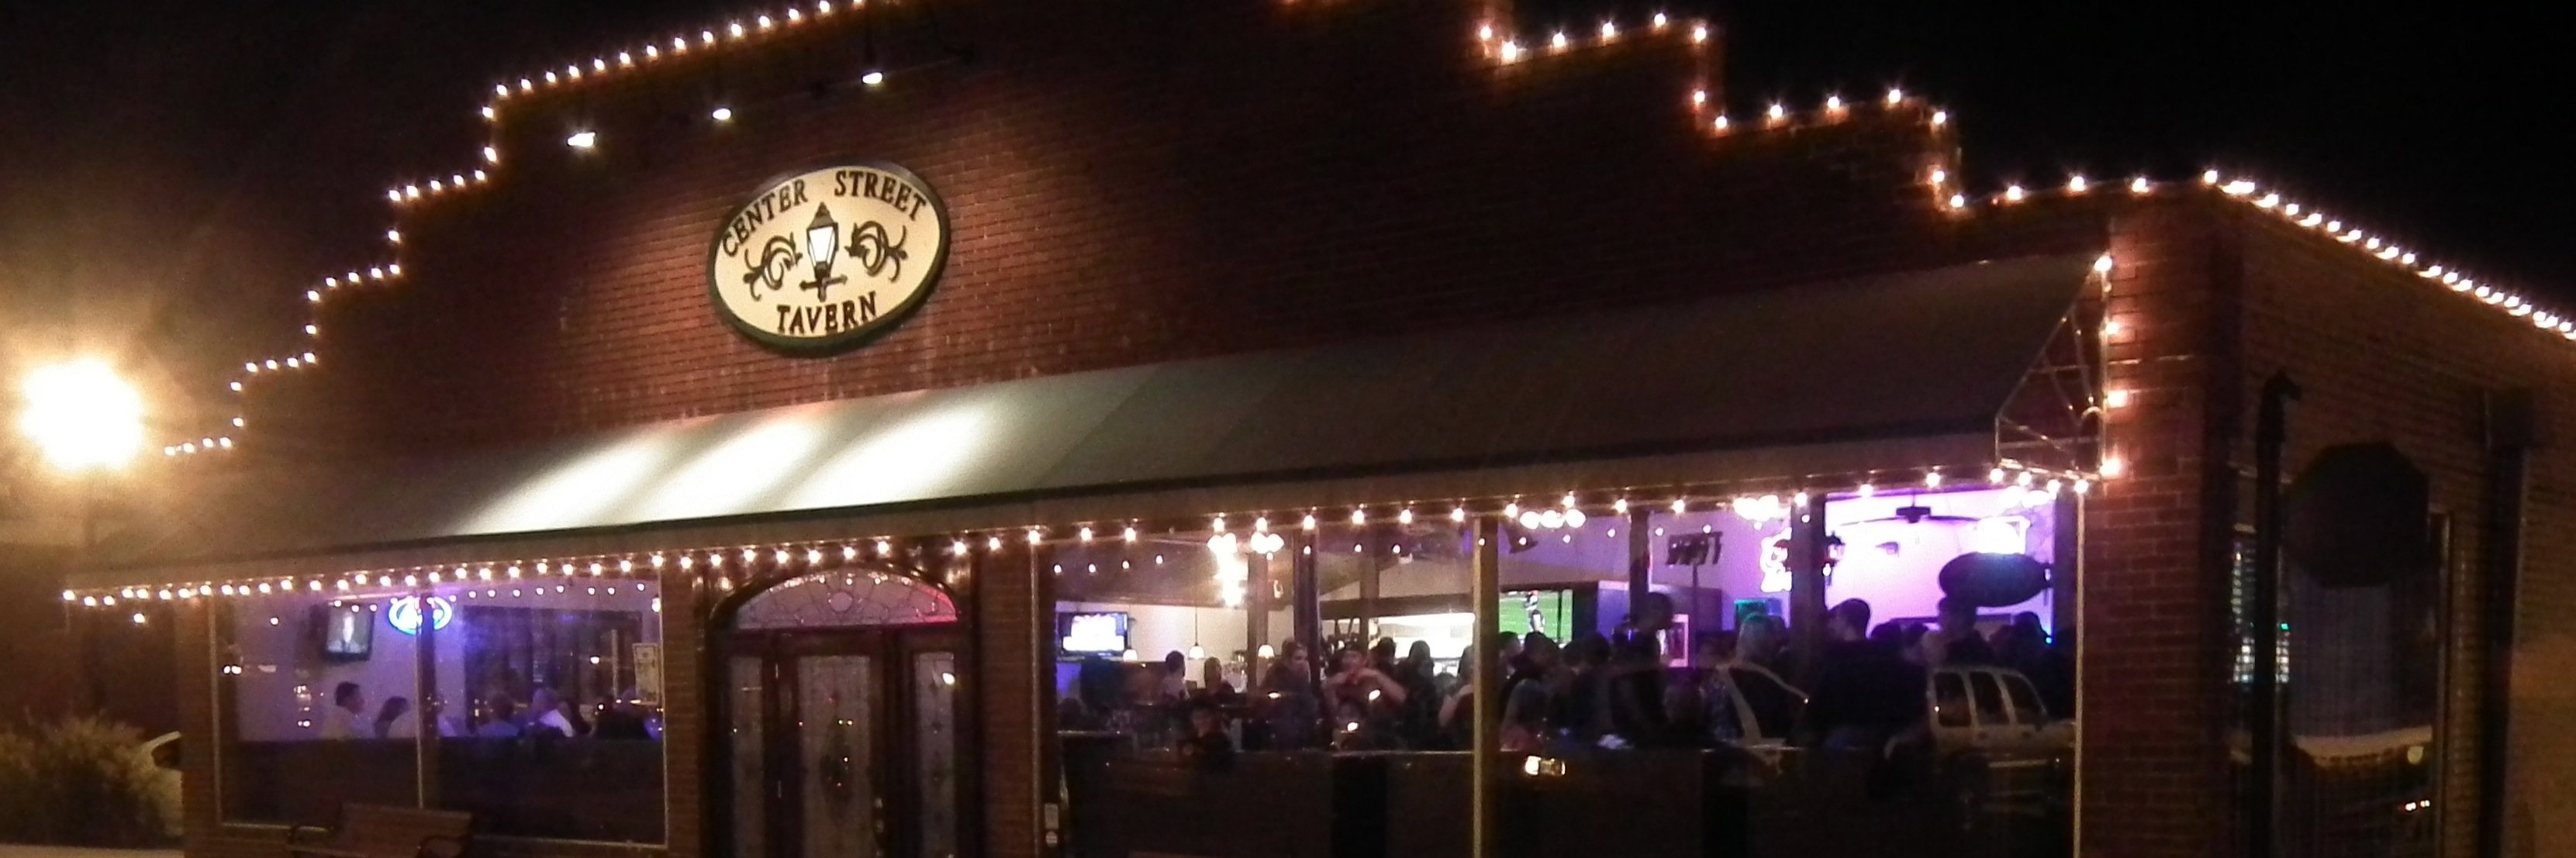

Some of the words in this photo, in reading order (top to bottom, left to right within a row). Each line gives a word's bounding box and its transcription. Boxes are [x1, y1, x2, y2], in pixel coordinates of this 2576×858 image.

[722, 179, 808, 257] CENTER
[834, 171, 926, 221] STREET
[777, 291, 876, 334] TAVERN
